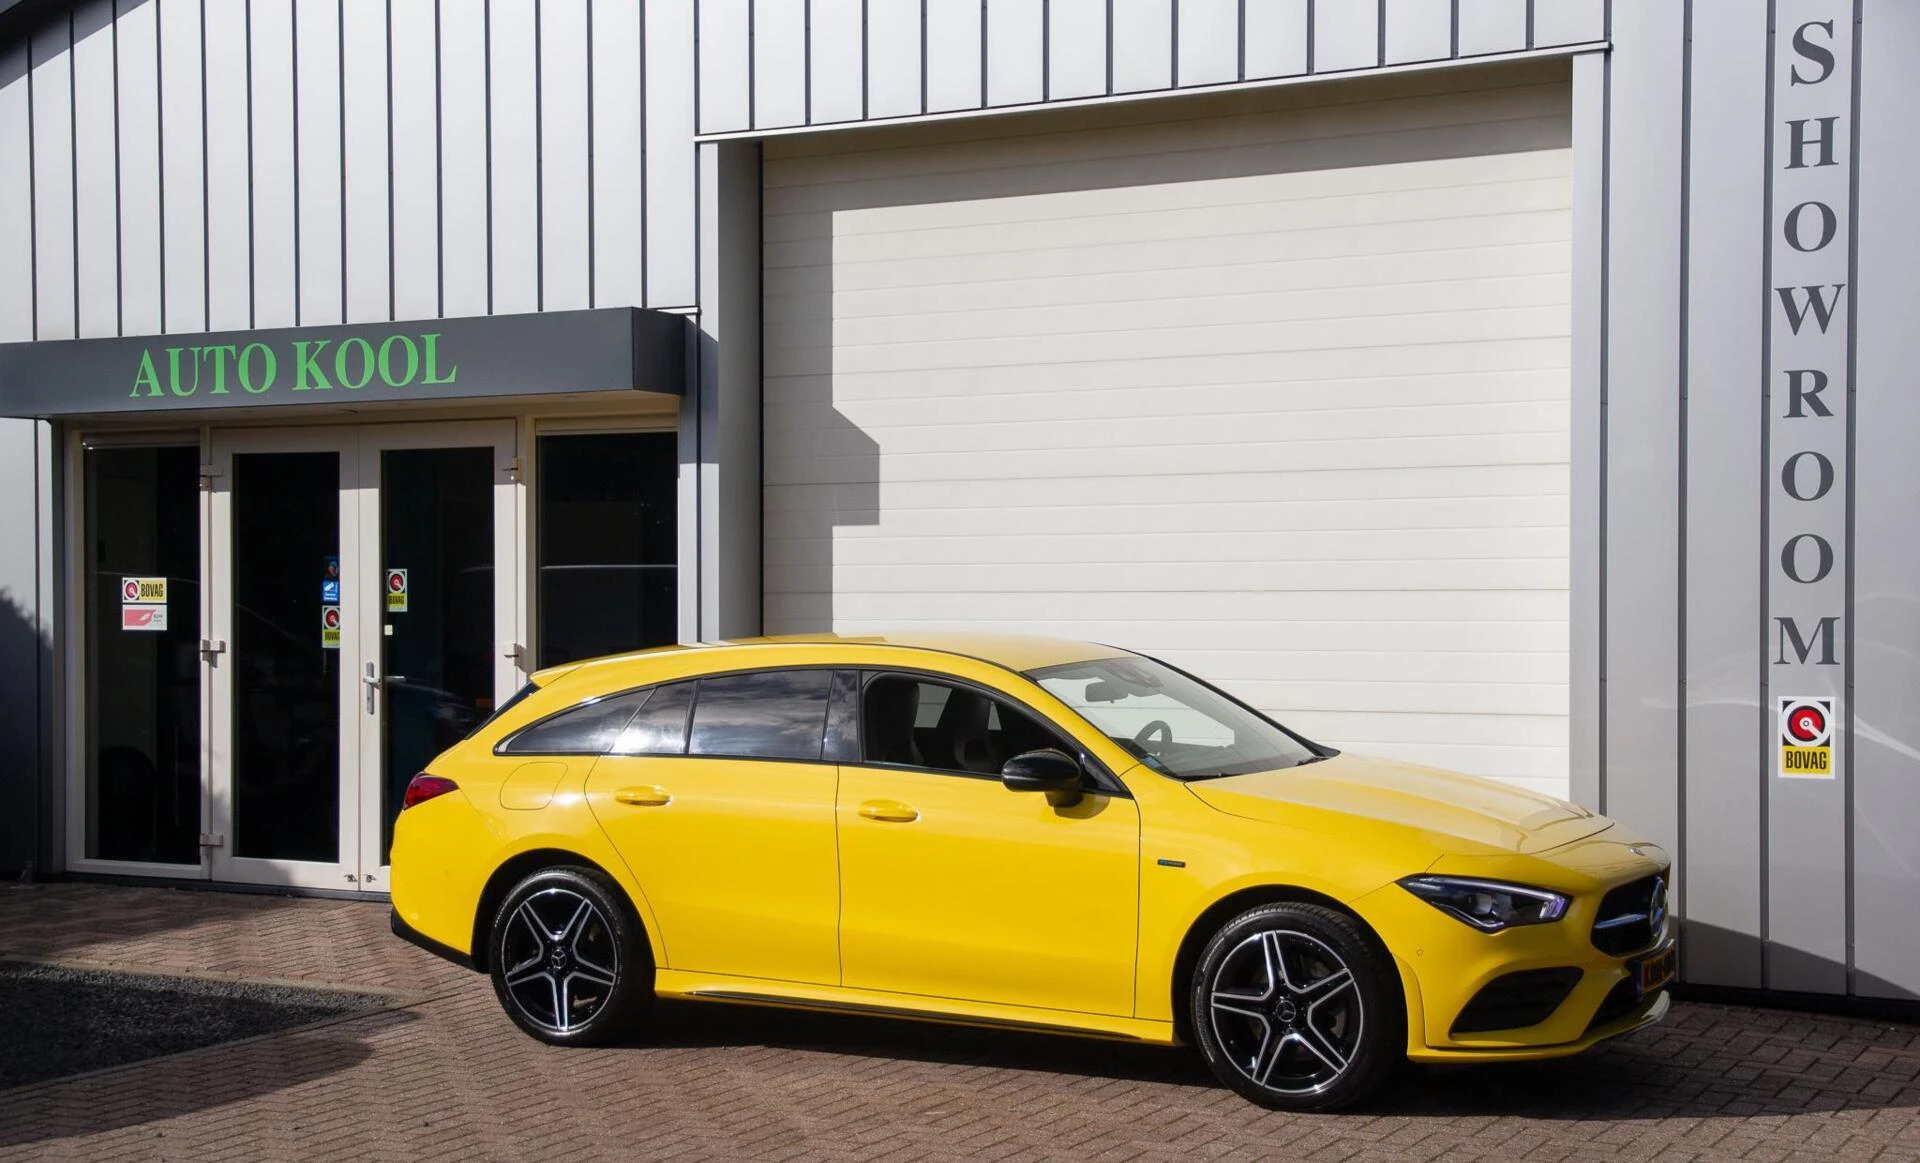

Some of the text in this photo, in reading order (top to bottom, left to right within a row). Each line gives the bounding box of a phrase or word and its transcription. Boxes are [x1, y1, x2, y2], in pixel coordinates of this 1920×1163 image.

[1773, 19, 1846, 665] SHOWROOM
[129, 333, 457, 397] AUTO KOOL
[140, 583, 164, 598] BOVAG
[1785, 750, 1827, 770] BOVAG
